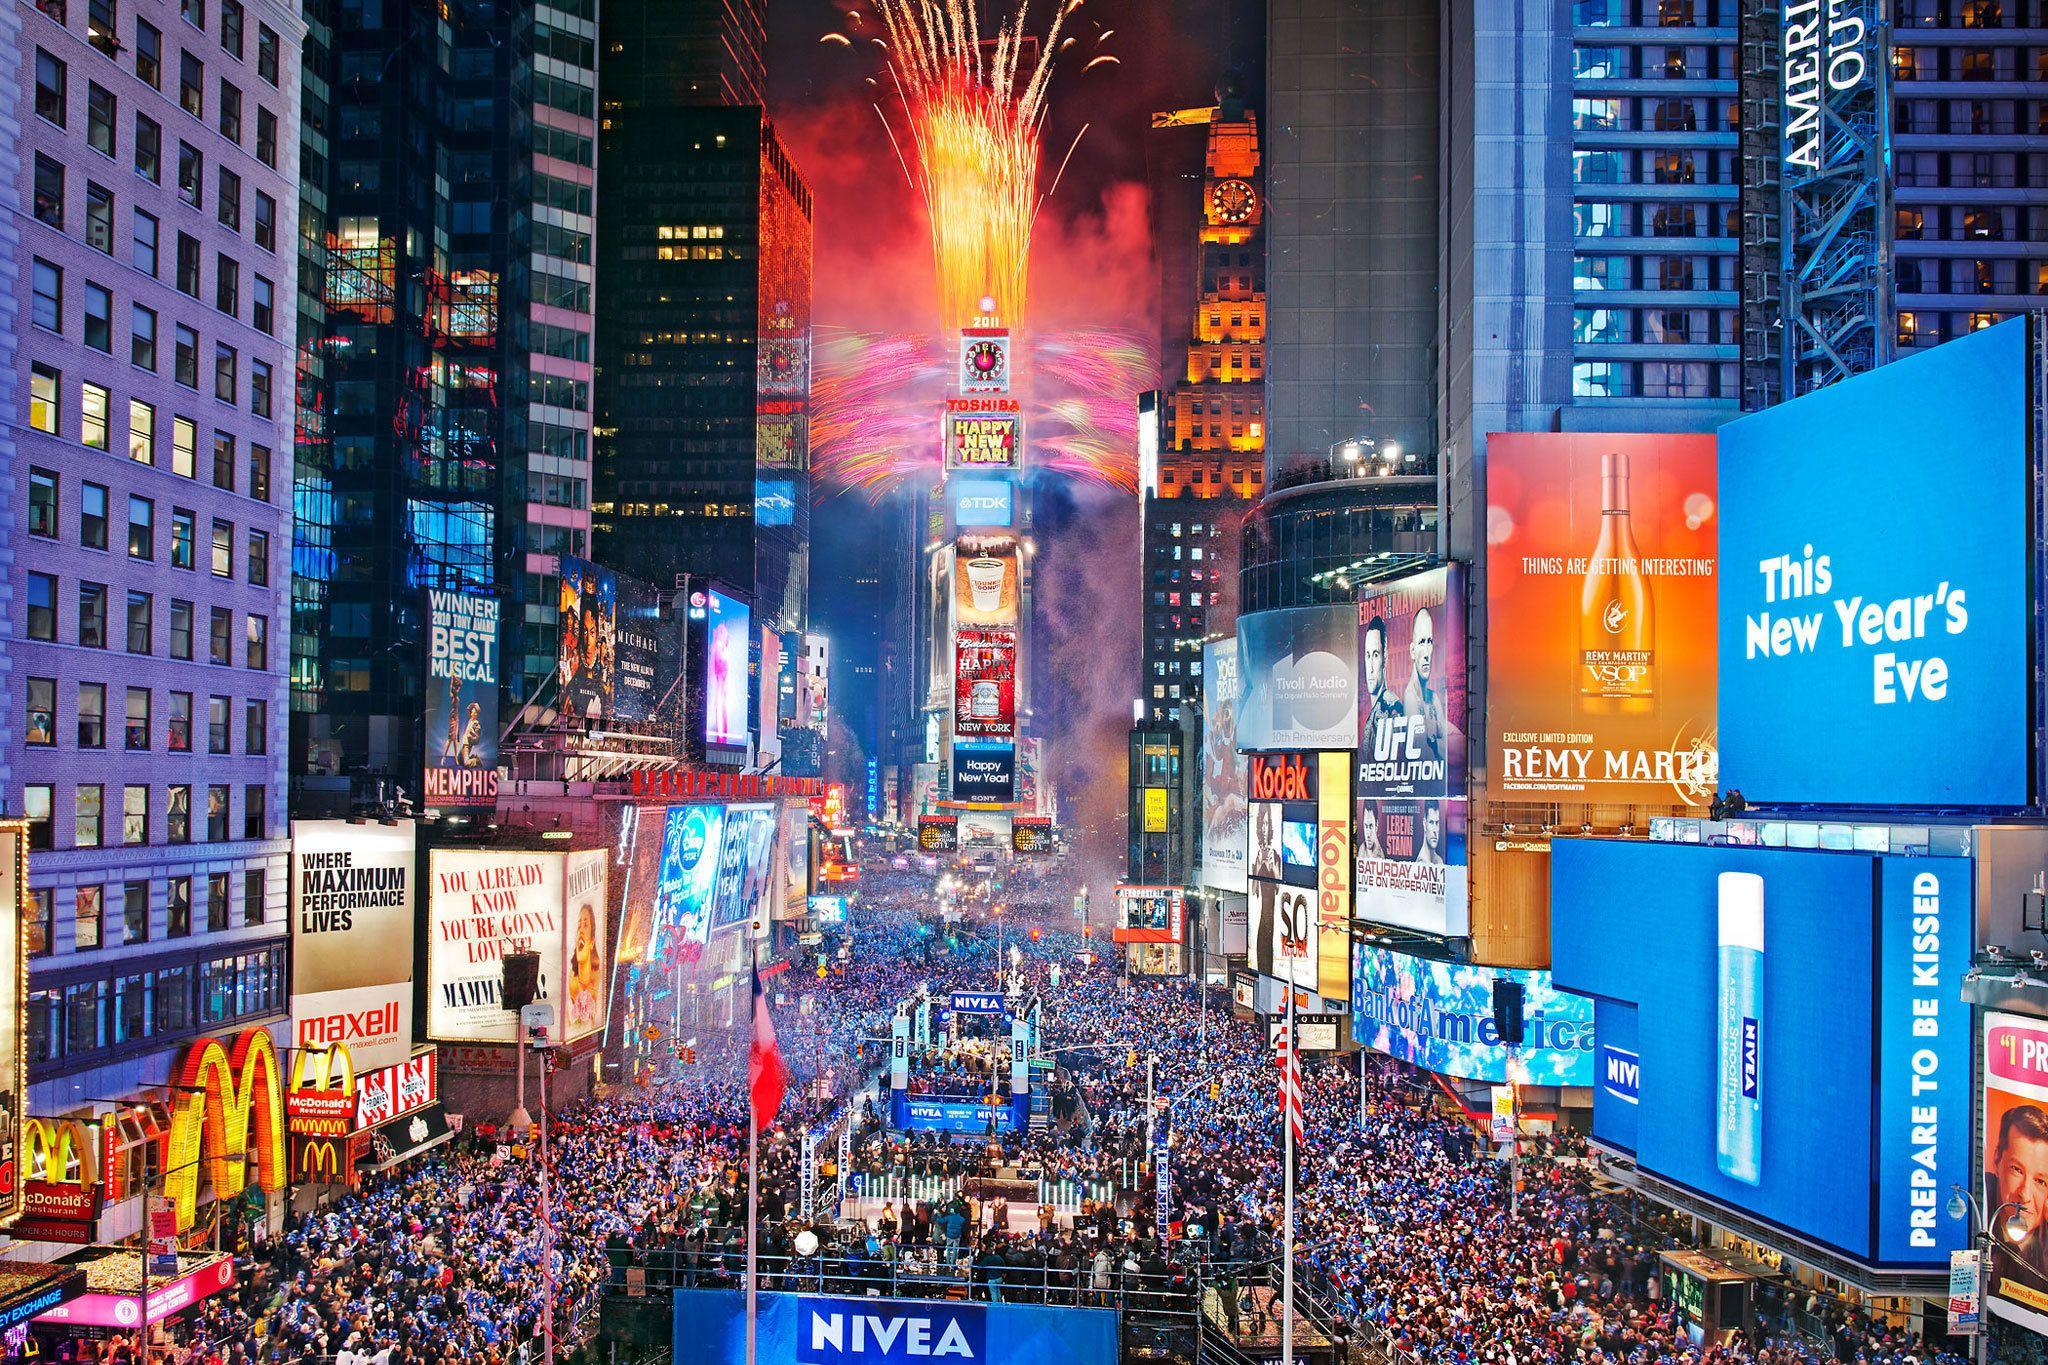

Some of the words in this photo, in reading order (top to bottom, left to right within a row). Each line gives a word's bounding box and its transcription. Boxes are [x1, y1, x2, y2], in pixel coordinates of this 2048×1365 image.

[973, 316, 999, 328] 2011
[948, 400, 1020, 411] TOSHIBA
[956, 420, 1014, 434] HAPPY
[964, 435, 1004, 448] NEW
[959, 448, 1008, 462] YEAR!
[970, 497, 1007, 509] TDK
[1522, 558, 1563, 575] THINGS
[1567, 558, 1587, 575] ARE
[1591, 558, 1637, 575] GETTING
[1760, 543, 1832, 603] This
[429, 590, 499, 620] WINNER!
[690, 608, 705, 619] LG
[1359, 594, 1388, 626] EDGAR
[453, 614, 471, 629] TONY
[473, 617, 496, 634] AWARD
[1746, 612, 1823, 660] New
[1834, 581, 1968, 648] Year's
[432, 626, 495, 664] BEST
[618, 630, 657, 652] MICHAEL
[959, 640, 1014, 649] Budweiser
[960, 659, 1011, 670] HAPPY
[1613, 652, 1648, 661] MARTIN
[431, 658, 495, 683] MUSICAL
[960, 671, 980, 679] NEW
[986, 671, 1010, 679] YEAR
[1217, 658, 1238, 679] YOGI
[1586, 666, 1647, 681] VSOP
[1874, 652, 1948, 704] Eve
[1217, 678, 1238, 702] BEAR
[1276, 676, 1305, 690] Tivoli
[1310, 676, 1347, 689] Audio
[959, 723, 980, 731] NEW
[984, 723, 1011, 732] YORK
[1374, 715, 1424, 761] UFC
[1272, 732, 1291, 743] 10th
[1293, 732, 1355, 746] Anniversary
[1504, 733, 1538, 743] EXCLUSIVE
[1540, 733, 1565, 743] LIMITED
[1567, 734, 1594, 744] EDITION
[967, 760, 1001, 772] Happy
[1359, 760, 1444, 782] RESOLUTION
[1503, 746, 1594, 779] RÉMY
[424, 768, 498, 796] MEMPHIS
[959, 773, 982, 783] New
[984, 773, 1009, 783] Year!
[1253, 755, 1308, 800] Kodak
[1147, 805, 1165, 815] LION
[1147, 816, 1165, 826] KING
[1386, 815, 1410, 835] LEBEN
[1386, 836, 1413, 857] STANN
[302, 852, 352, 870] WHERE
[1358, 860, 1411, 879] SATURDAY
[303, 867, 405, 894] MAXIMUM
[440, 870, 471, 893] YOU
[476, 864, 544, 891] ALREADY
[1320, 820, 1348, 936] Kodak
[1358, 874, 1374, 886] LIVE
[1376, 876, 1388, 888] ON
[303, 890, 405, 912] PERFORMANCE
[472, 890, 518, 915] KNOW
[302, 910, 352, 934] LIVES
[440, 917, 498, 941] YOU'RE
[502, 910, 555, 936] GONNA
[1913, 872, 1940, 987] KISSED
[468, 938, 506, 964] LOVE
[955, 997, 1000, 1009] NIVEA
[300, 1001, 399, 1046] maxell
[1354, 978, 1399, 1028] Bank
[1399, 996, 1417, 1029] of
[1418, 998, 1595, 1051] Ameica
[1913, 998, 1938, 1037] BE
[1745, 1024, 1756, 1091] NIVEA
[1728, 1028, 1739, 1131] Smoothness
[1912, 1050, 1938, 1095] TO
[290, 1098, 352, 1108] McDonald's
[911, 1108, 942, 1117] NIVEA
[1910, 1106, 1938, 1247] PREPARE
[25, 1193, 91, 1208] cDonald's
[26, 1206, 78, 1216] Restaurant
[16, 1226, 40, 1236] OPEN
[55, 1229, 85, 1239] HOURS
[12, 1289, 62, 1321] EXCHANGE
[812, 1310, 975, 1358] NIVEA
